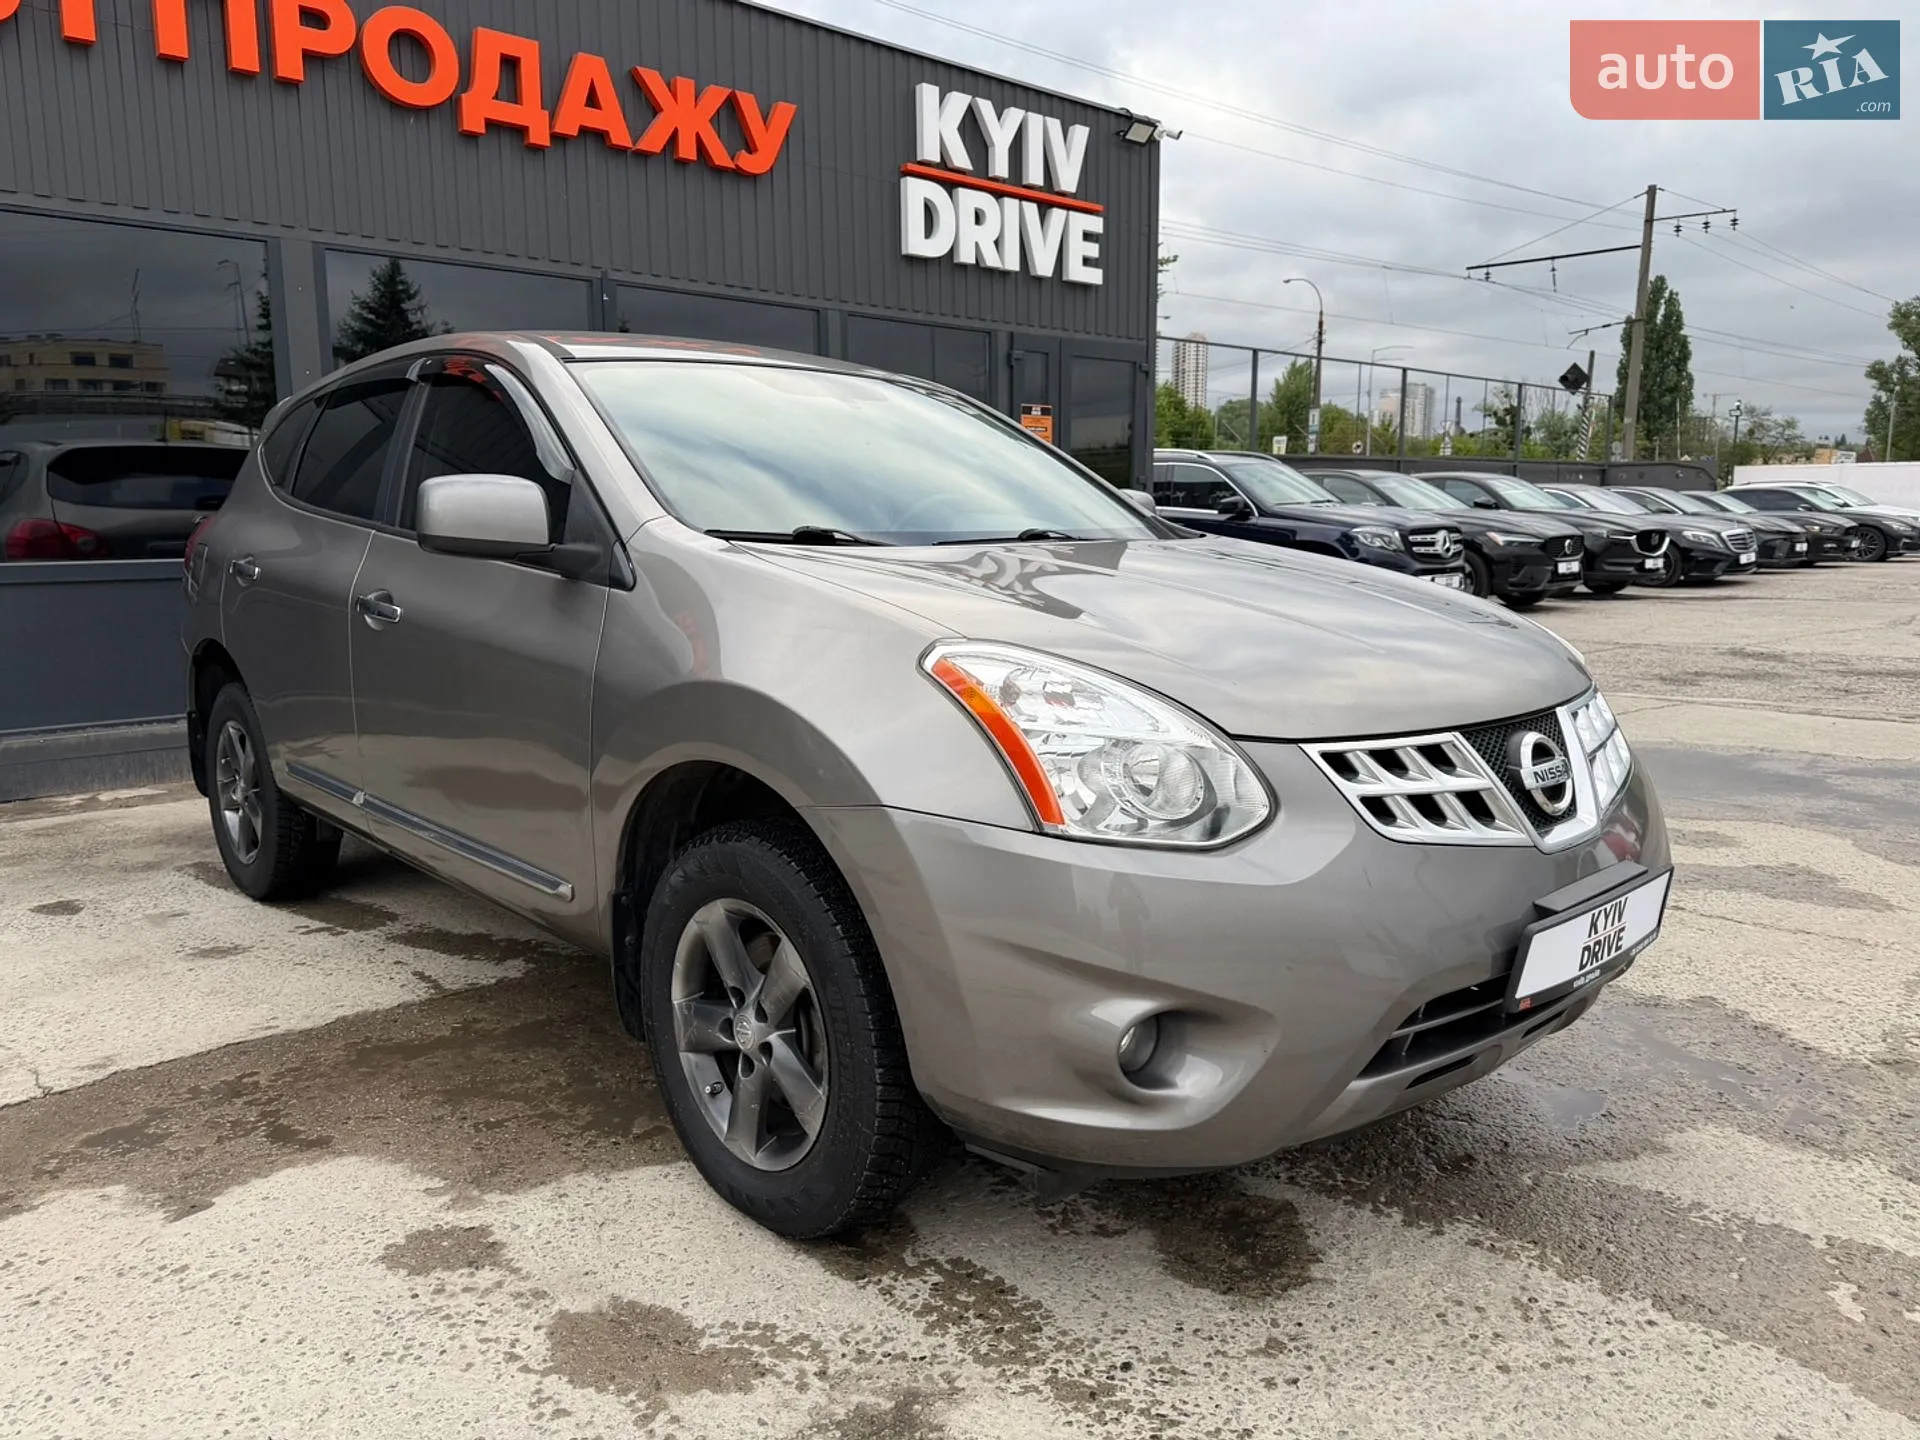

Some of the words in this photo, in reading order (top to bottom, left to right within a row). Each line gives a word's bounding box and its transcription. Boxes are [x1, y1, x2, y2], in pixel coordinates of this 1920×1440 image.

[915, 82, 1090, 194] KYIV
[901, 176, 1104, 285] DRIVE
[1579, 925, 1627, 972] DRIVE
[1588, 896, 1629, 938] KYIV
